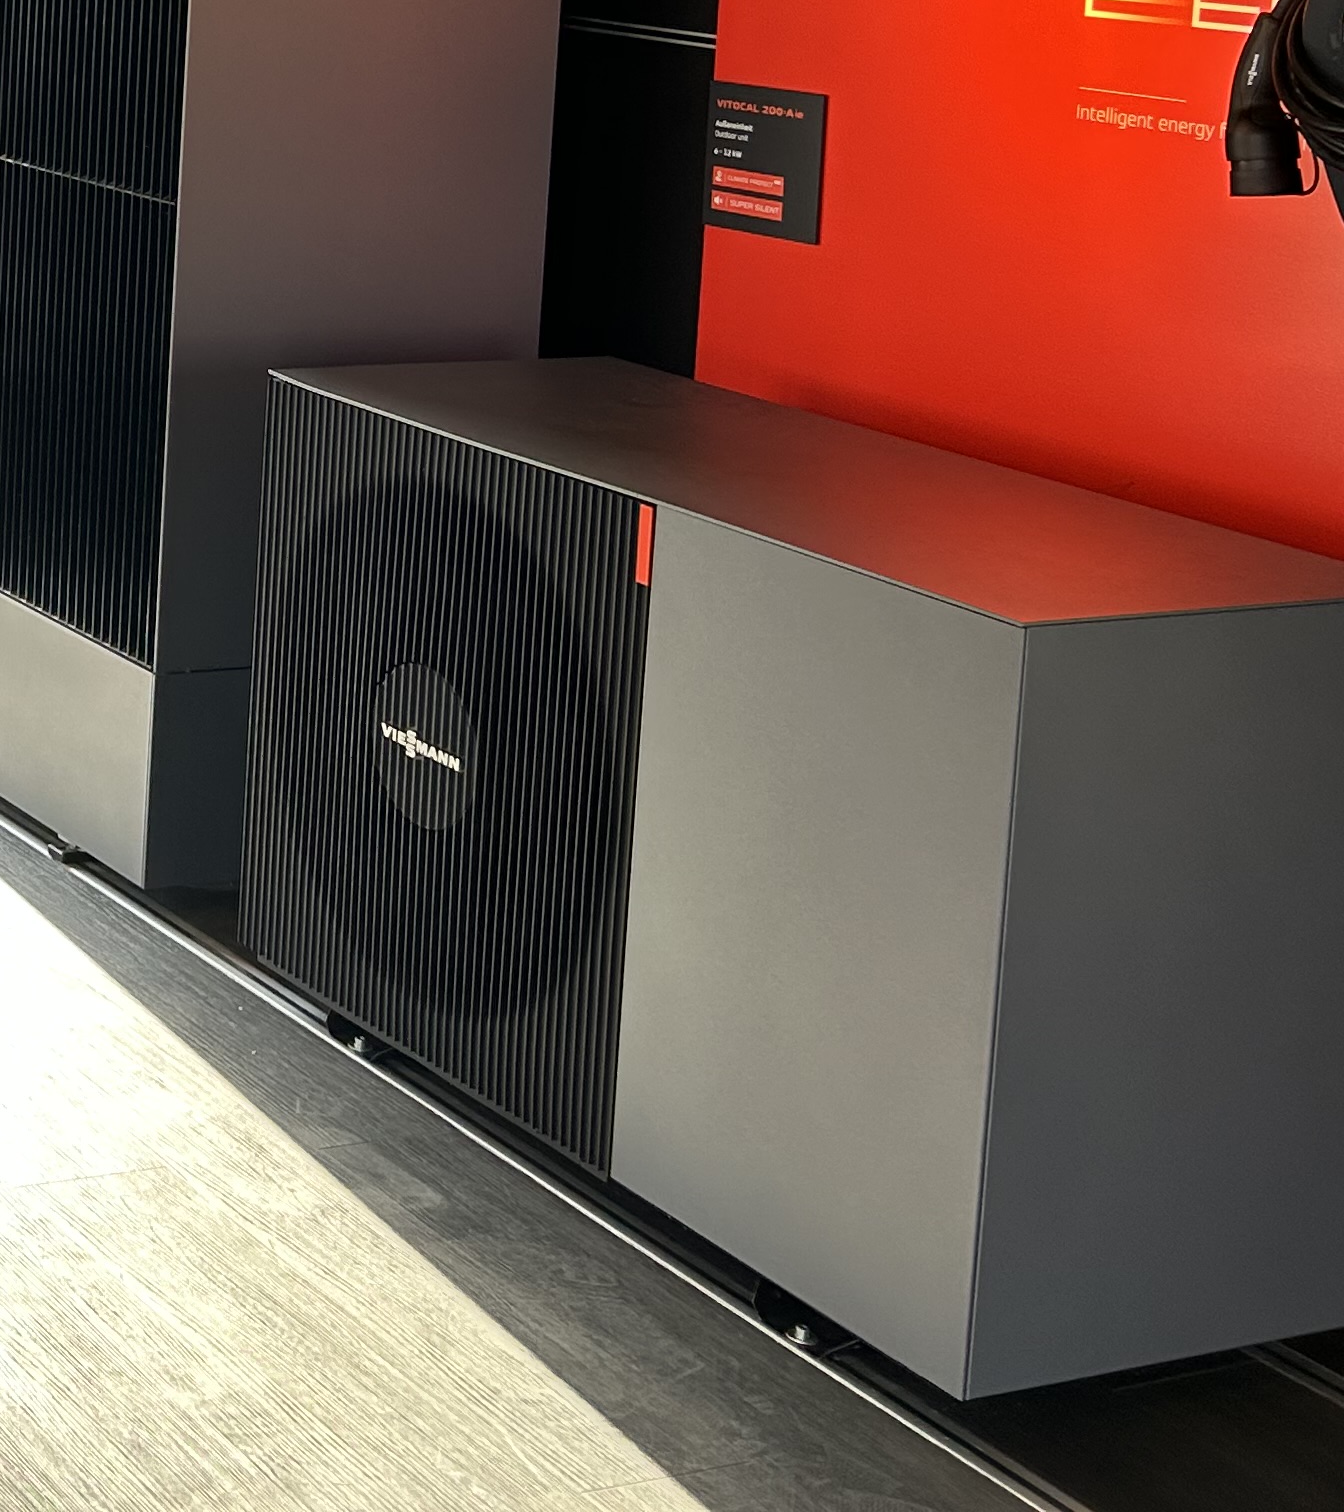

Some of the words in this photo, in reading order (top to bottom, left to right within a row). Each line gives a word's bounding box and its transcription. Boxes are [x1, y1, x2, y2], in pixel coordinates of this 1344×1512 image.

[716, 98, 760, 113] VITOCAL
[1075, 104, 1154, 130] Intelligent
[1158, 118, 1215, 142] energy
[729, 199, 754, 209] SUPER
[754, 203, 780, 214] SILENT
[380, 721, 460, 772] VIESSMANN
